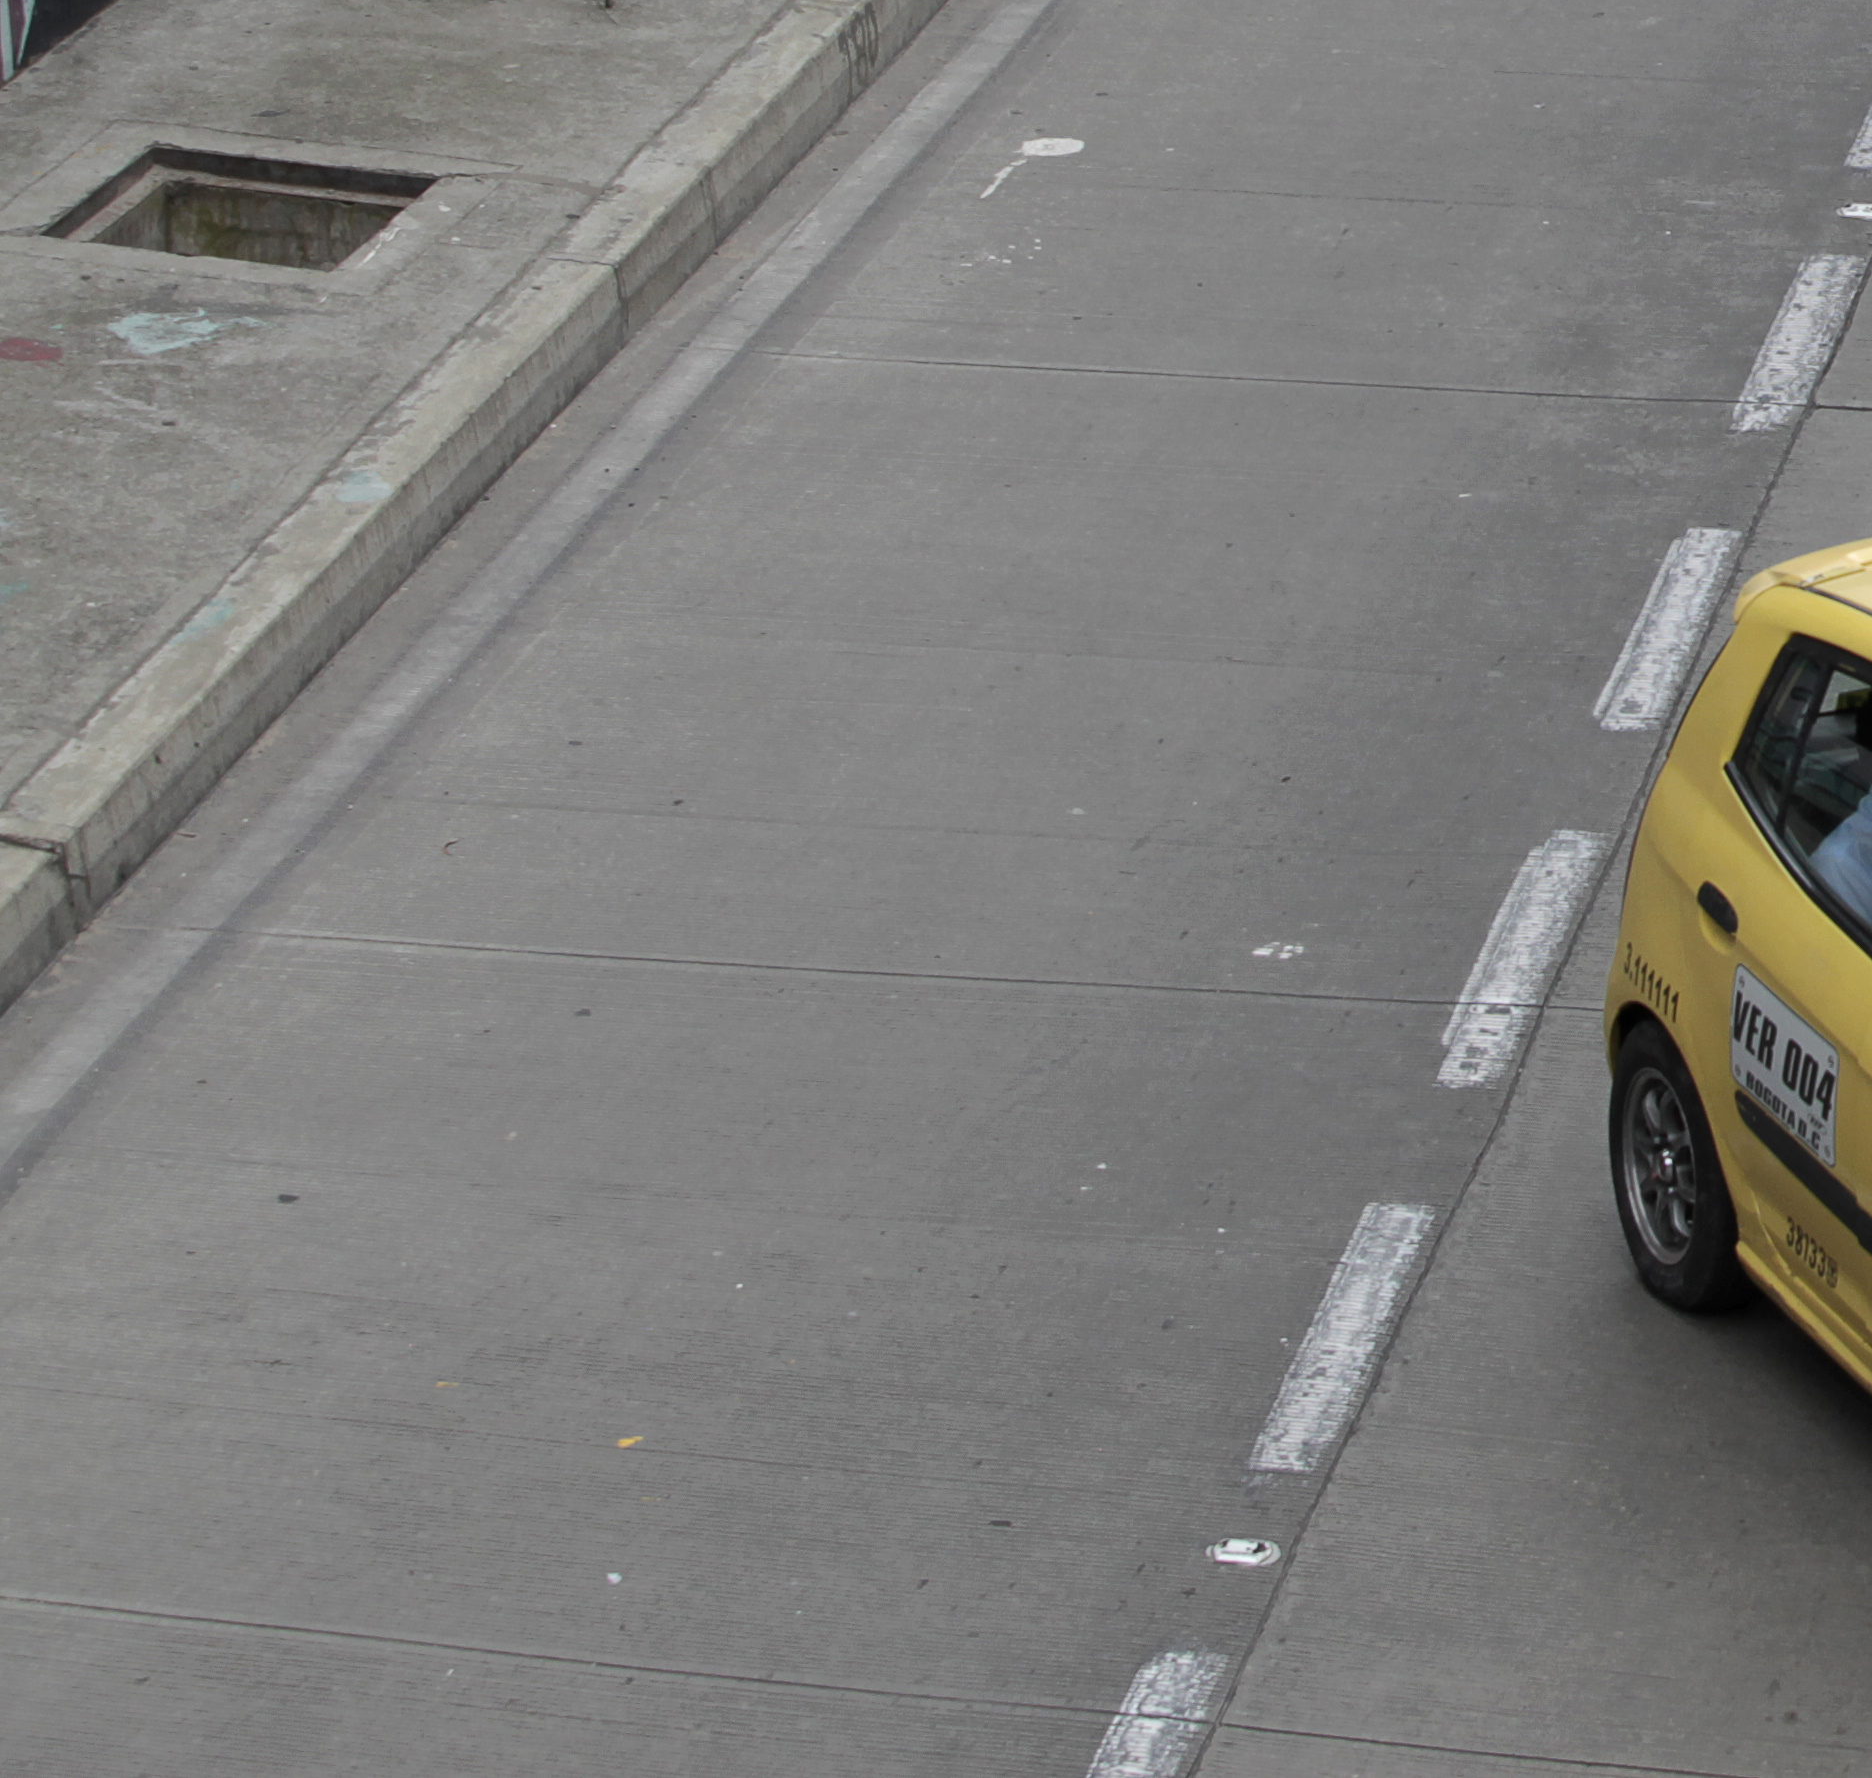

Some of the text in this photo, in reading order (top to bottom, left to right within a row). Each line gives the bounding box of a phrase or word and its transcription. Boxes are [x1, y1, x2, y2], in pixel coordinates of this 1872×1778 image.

[1733, 990, 1835, 1121] VER 004
[1746, 1070, 1796, 1128] BOGOTA
